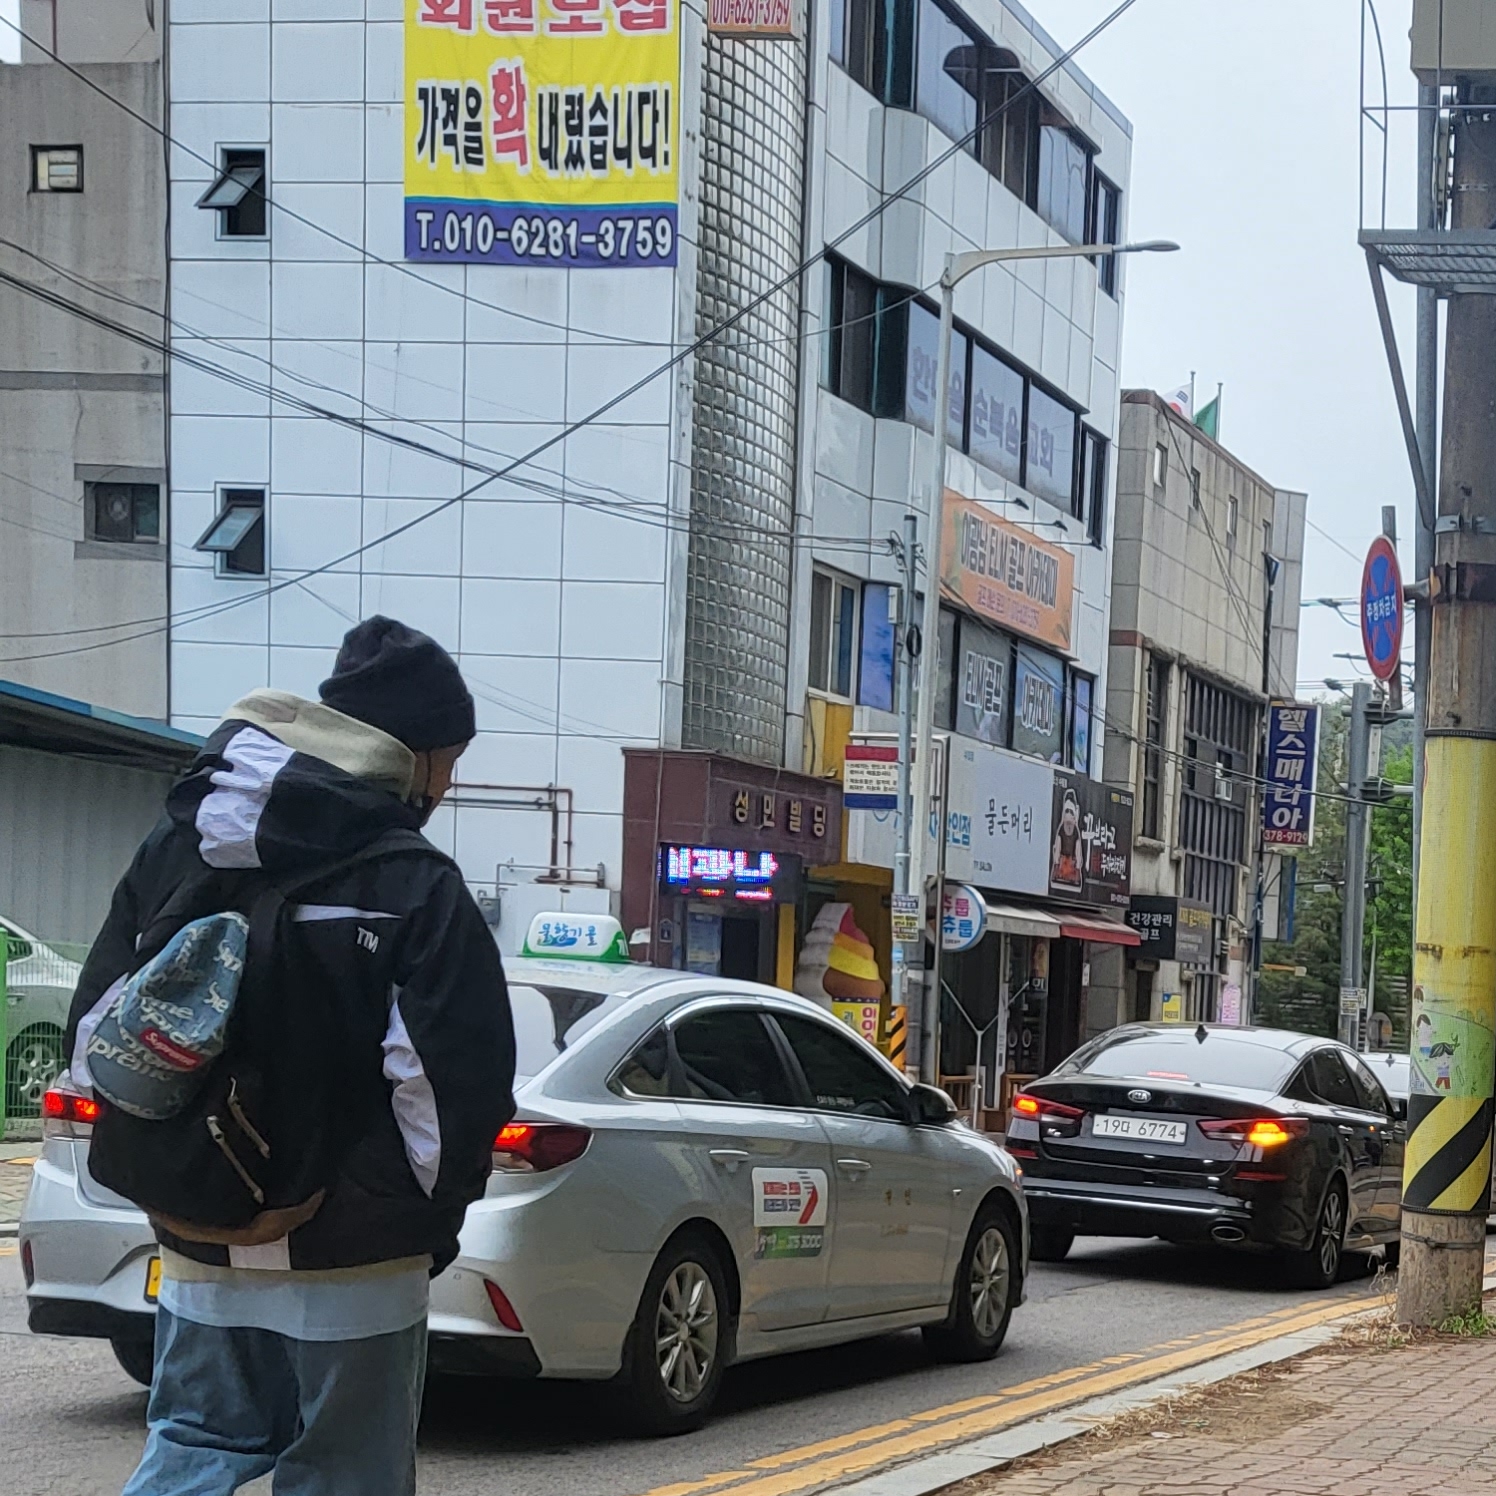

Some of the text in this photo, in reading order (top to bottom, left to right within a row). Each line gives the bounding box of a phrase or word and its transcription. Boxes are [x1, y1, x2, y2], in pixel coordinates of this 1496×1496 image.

[417, 65, 670, 171] 가격을 확 내렸습니다!
[416, 211, 673, 258] T.010-6281-3759
[1366, 594, 1397, 622] 주정차금지
[735, 789, 827, 837] 성민빌딩
[985, 798, 1032, 844] 물든머리
[1130, 912, 1172, 927] 건강관리
[1140, 927, 1160, 941] 골프
[1138, 1122, 1177, 1139] 6774
